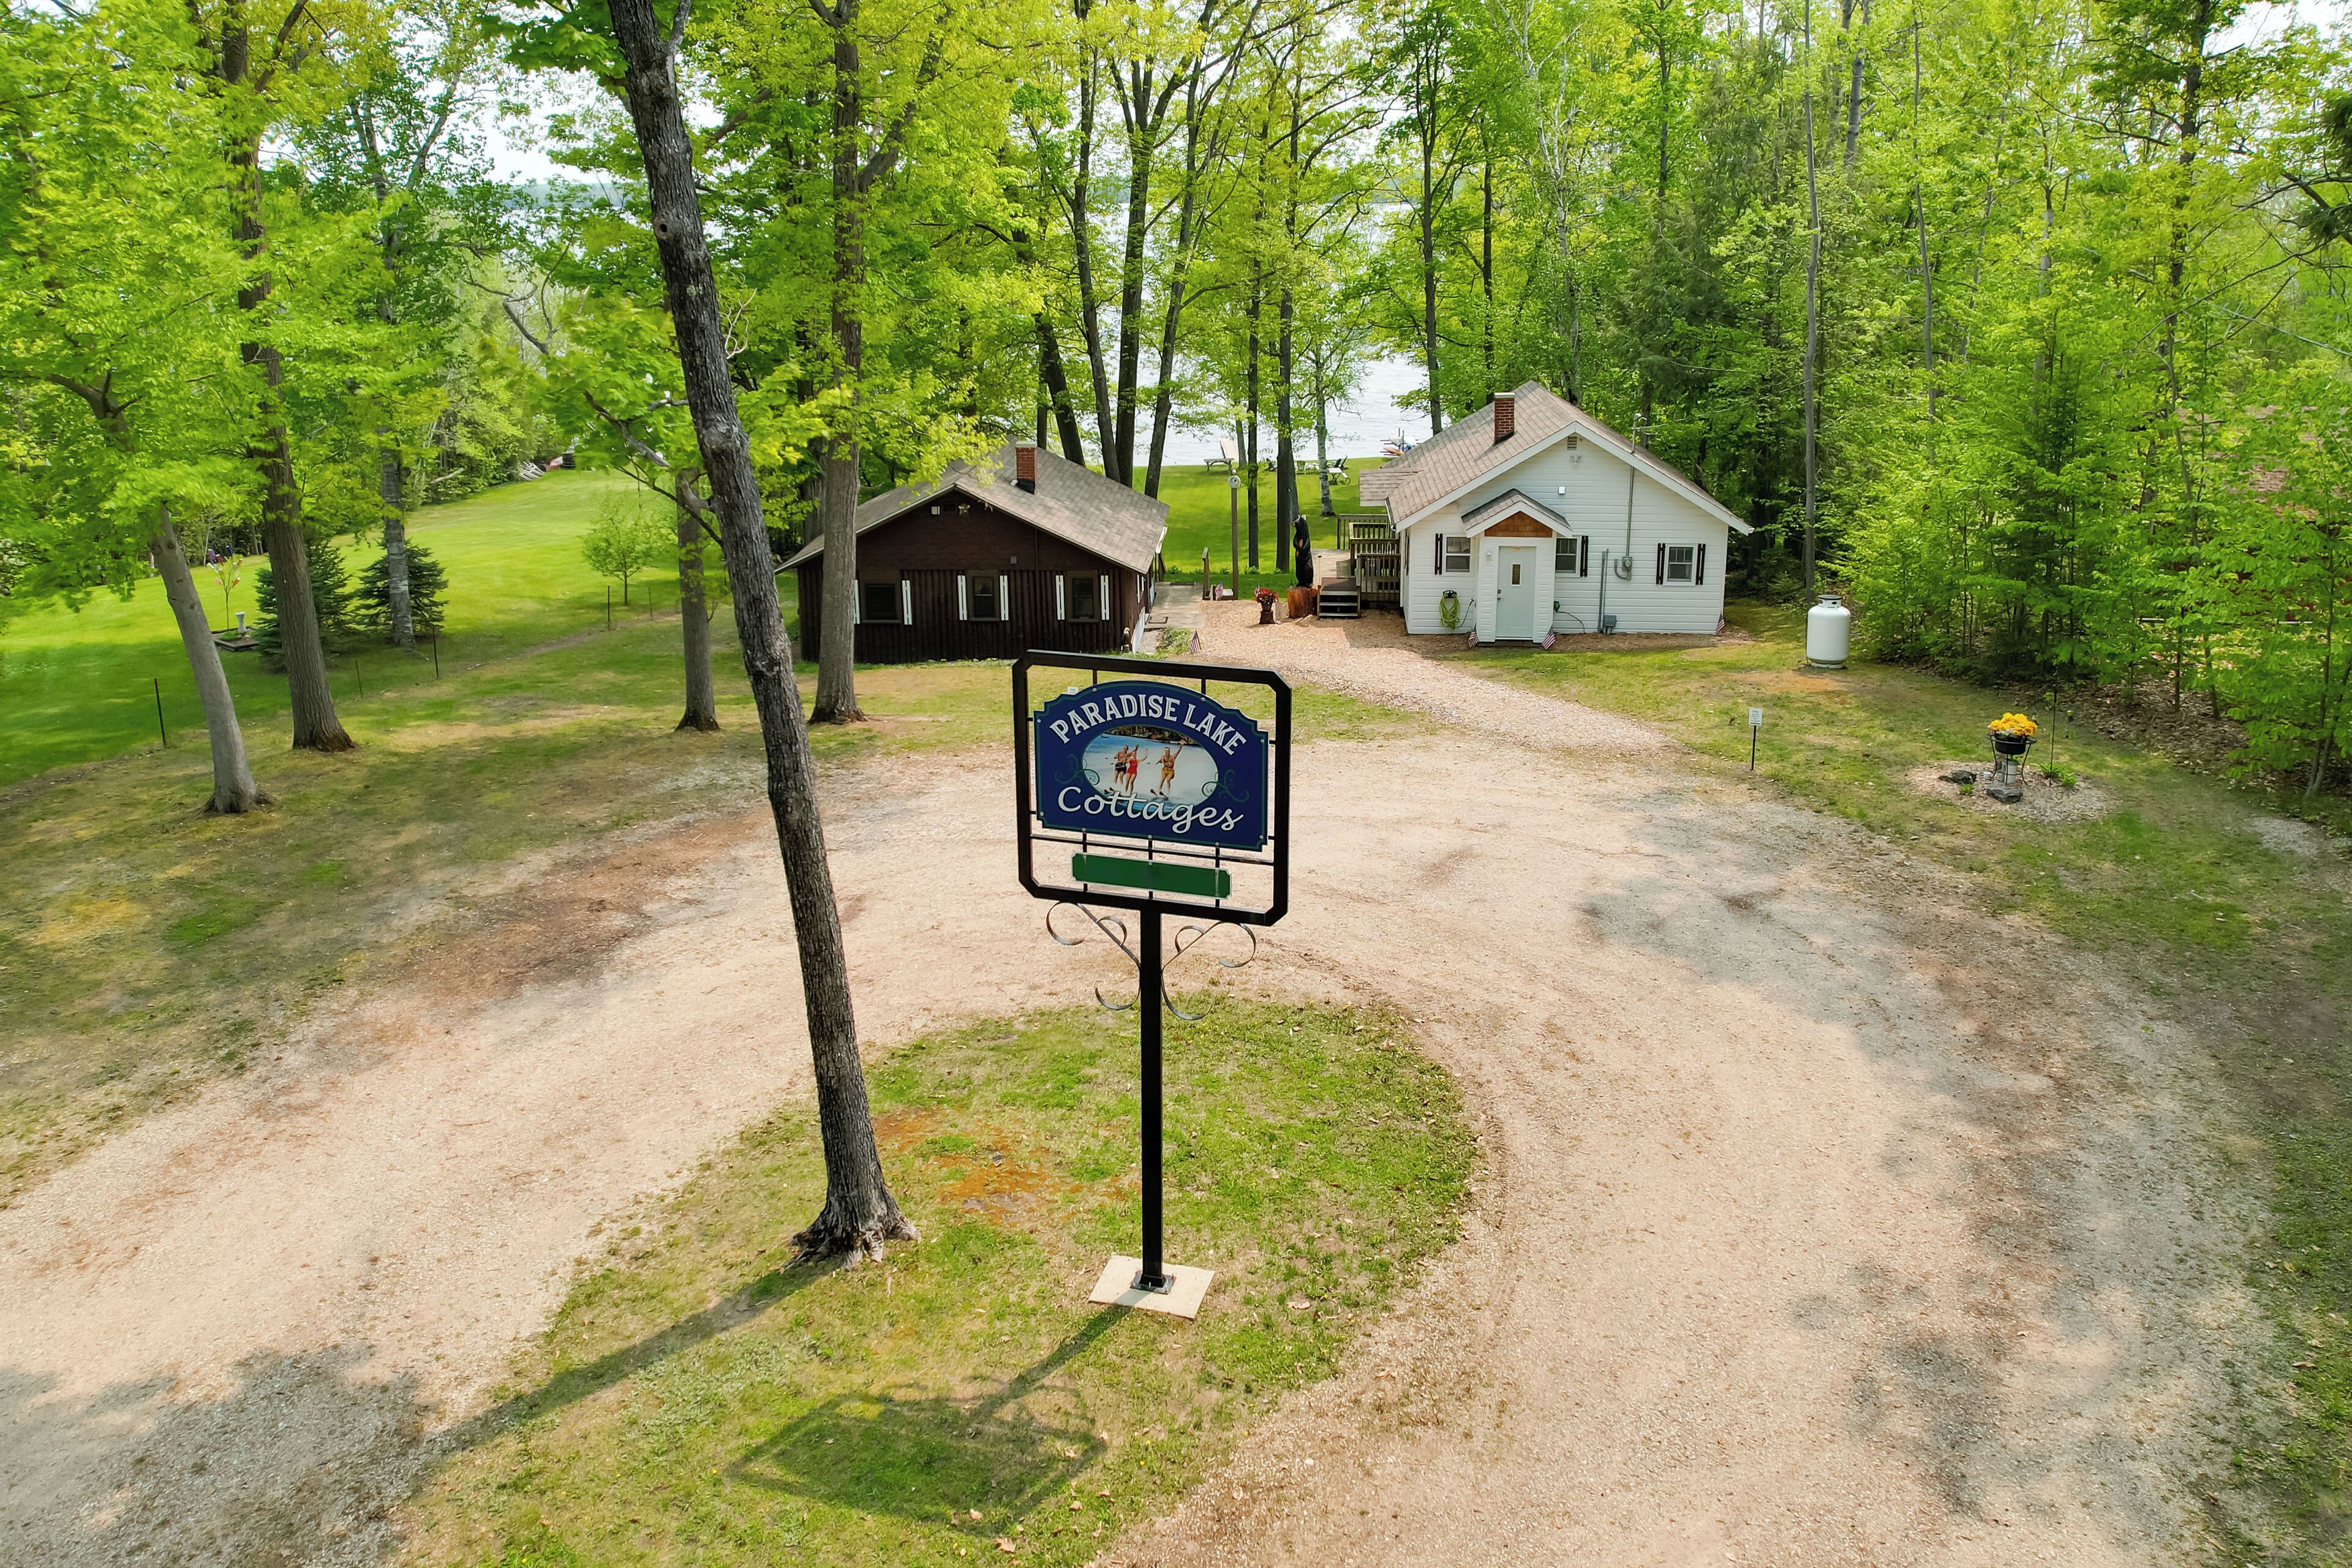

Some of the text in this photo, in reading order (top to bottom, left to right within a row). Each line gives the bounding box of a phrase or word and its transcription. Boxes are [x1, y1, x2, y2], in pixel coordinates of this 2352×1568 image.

[1049, 694, 1247, 756] PARADISE LAKE
[1058, 786, 1244, 834] Cottages
